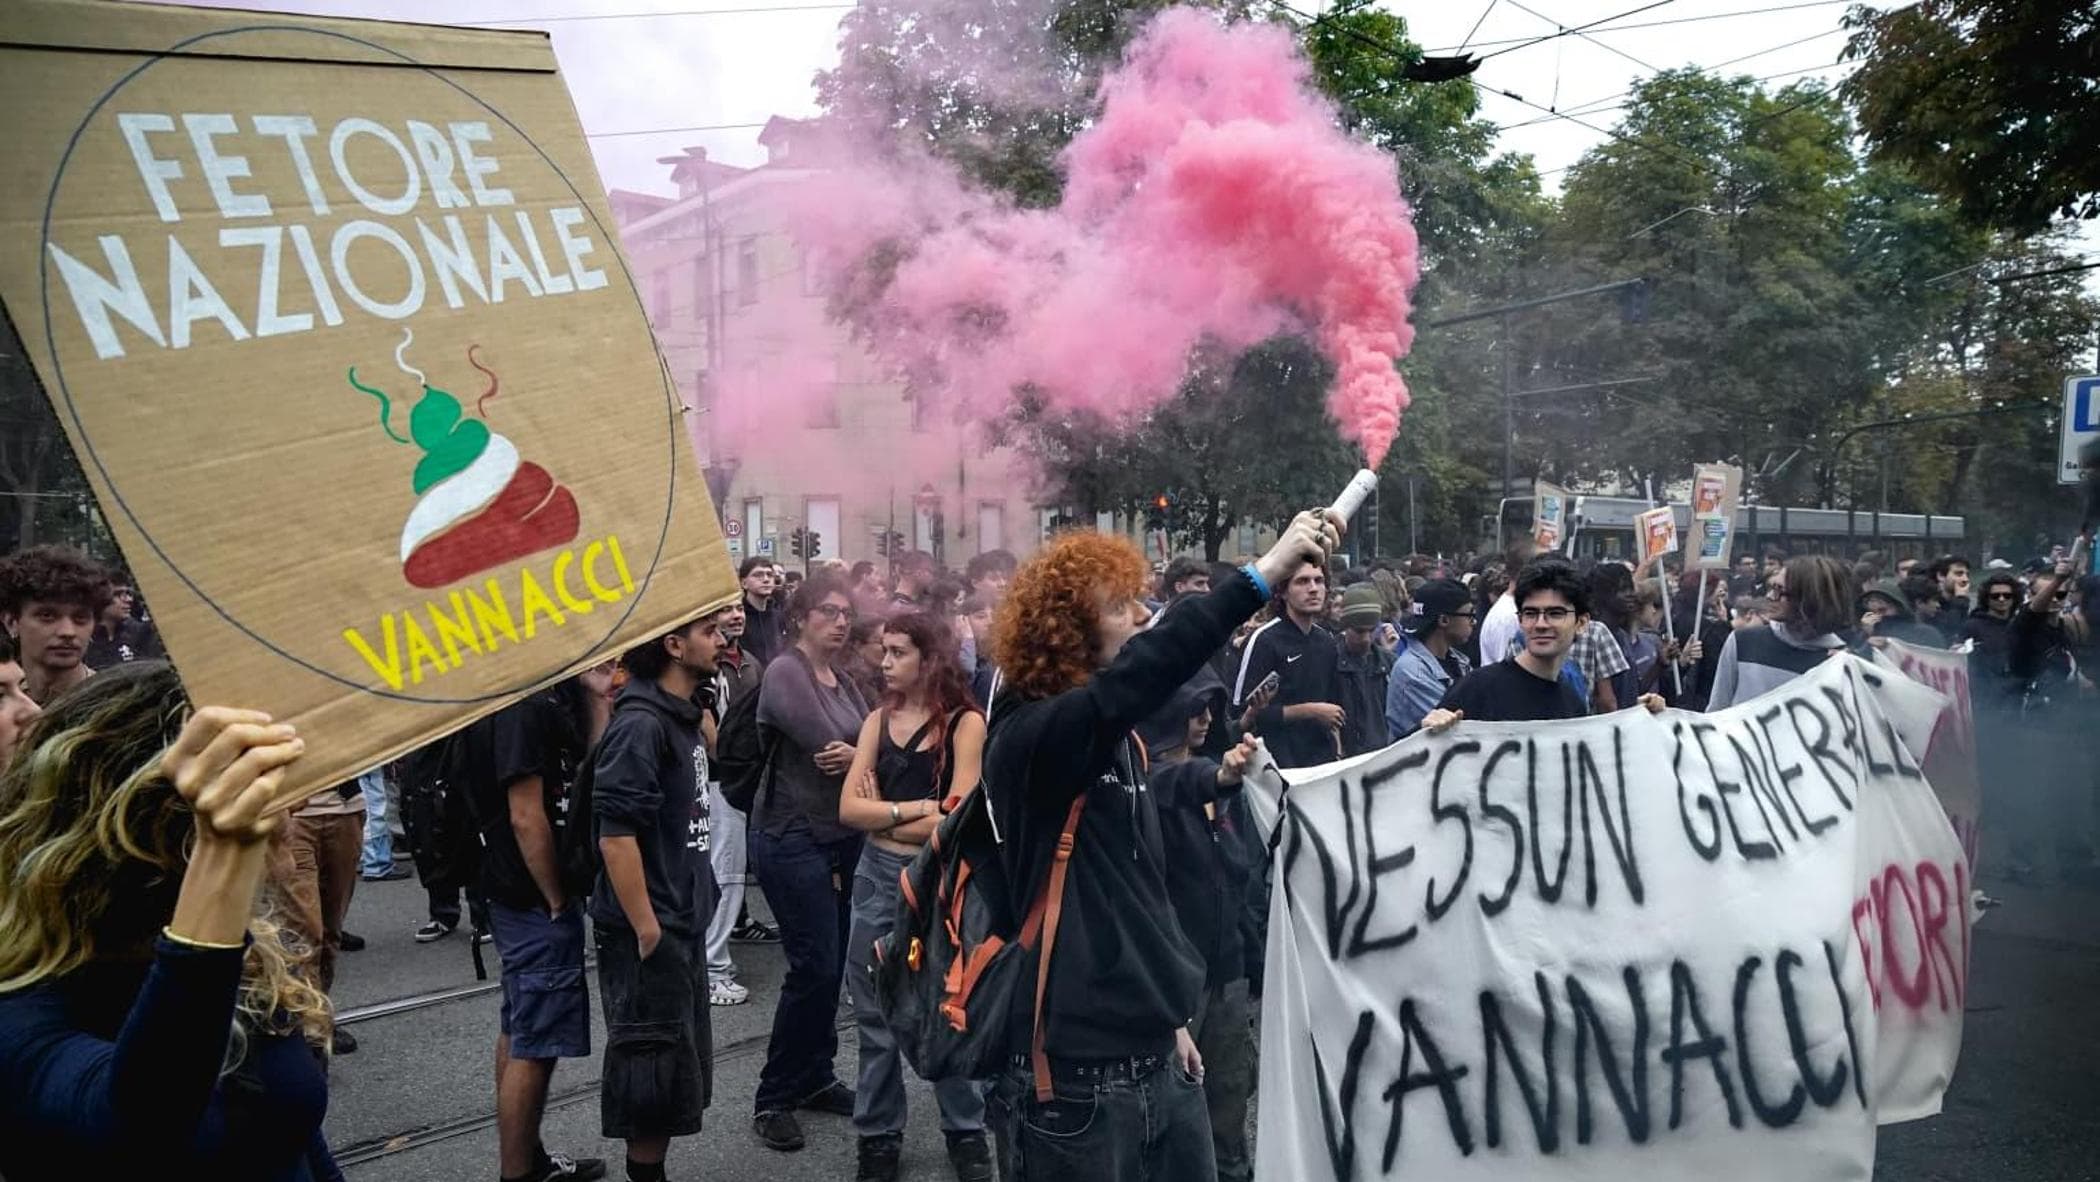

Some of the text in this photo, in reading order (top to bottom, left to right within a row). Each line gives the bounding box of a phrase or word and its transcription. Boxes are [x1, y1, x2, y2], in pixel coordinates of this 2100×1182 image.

[118, 112, 514, 223] FETORE
[47, 206, 609, 361] NAZIONALE
[343, 535, 636, 693] VANNACCI
[1284, 726, 1645, 960] NESSUN
[1309, 940, 1868, 1182] VANNACCI
